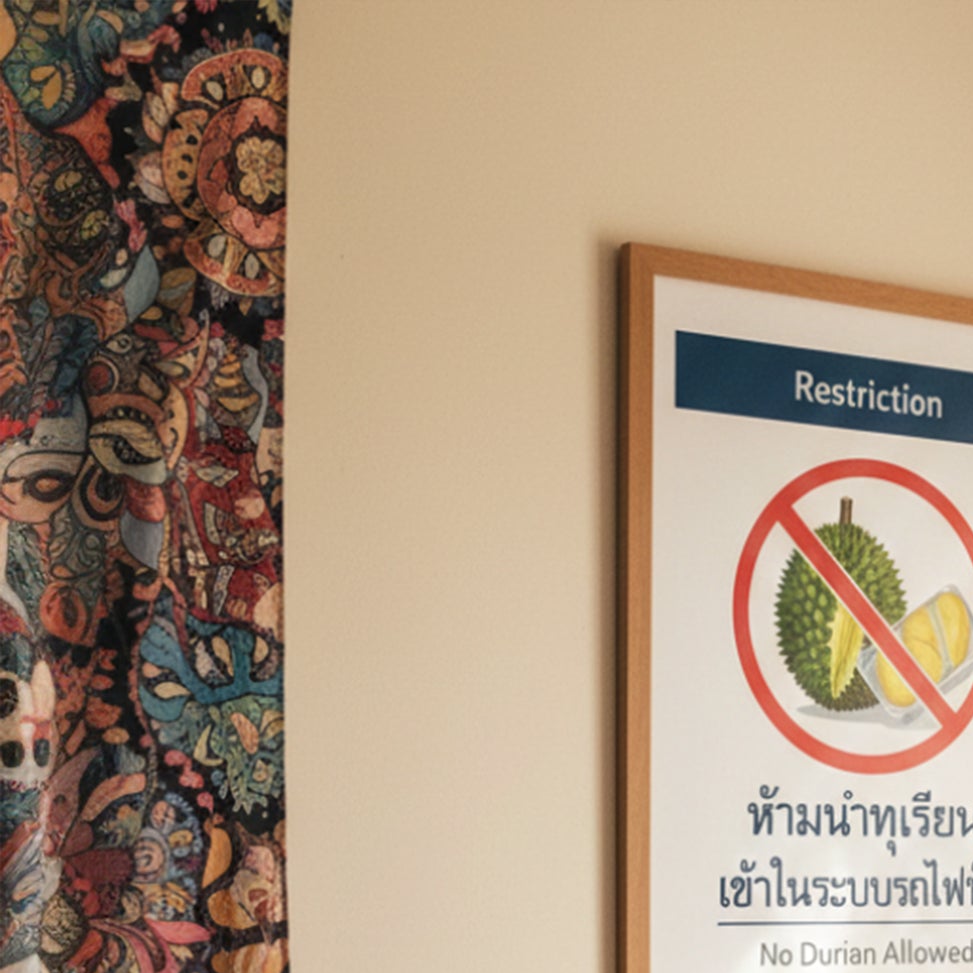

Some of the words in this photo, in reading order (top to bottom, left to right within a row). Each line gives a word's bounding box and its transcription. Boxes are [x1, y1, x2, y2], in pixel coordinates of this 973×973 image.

[794, 370, 943, 419] Restriction
[760, 942, 793, 967] No
[801, 940, 877, 966] Durian
